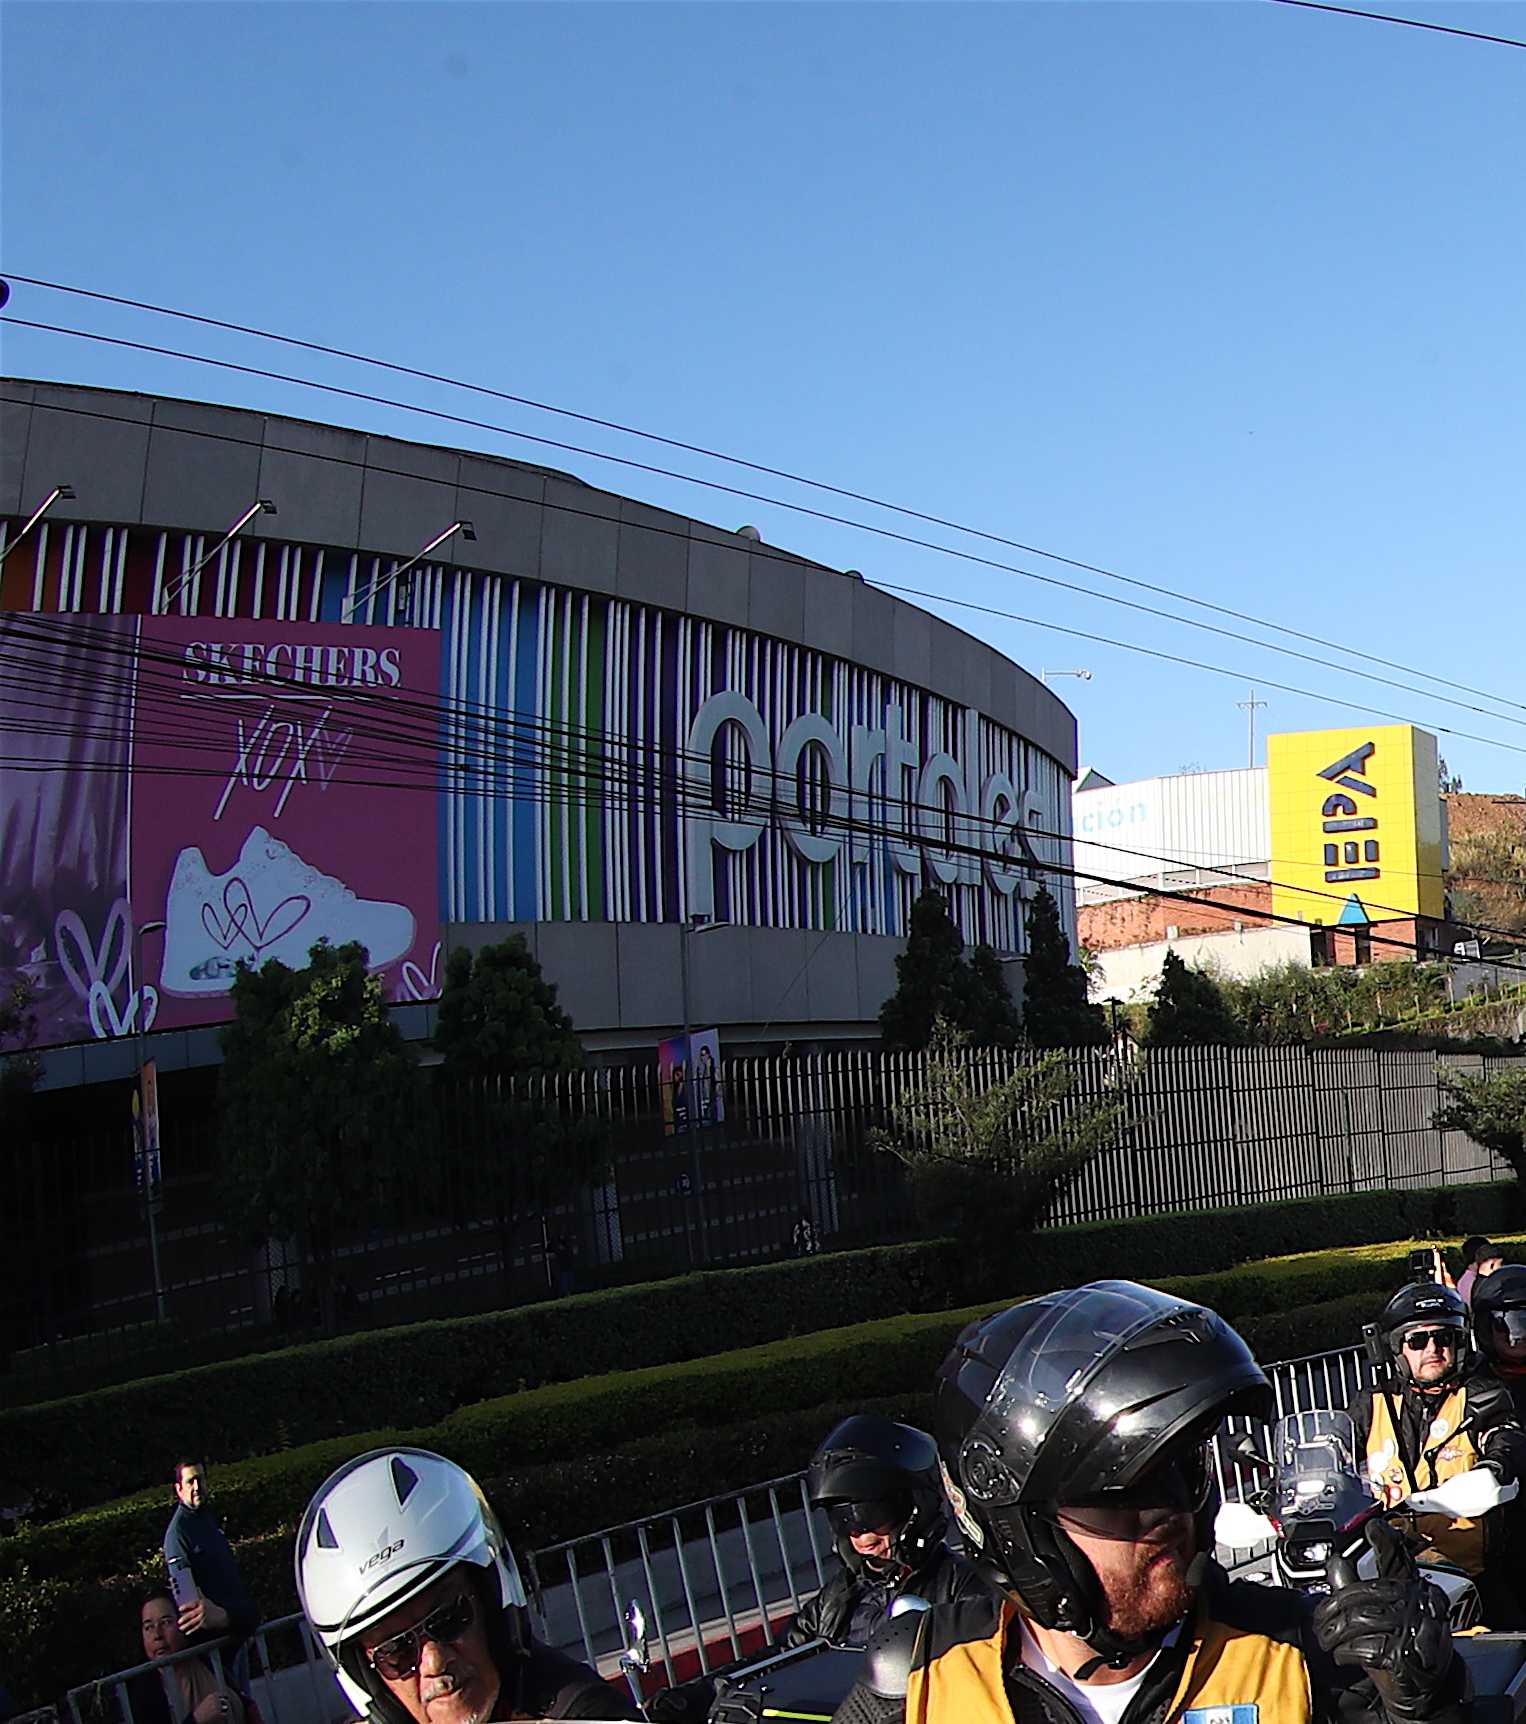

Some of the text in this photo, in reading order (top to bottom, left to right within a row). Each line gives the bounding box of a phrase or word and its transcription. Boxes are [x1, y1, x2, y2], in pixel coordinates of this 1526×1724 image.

[182, 641, 402, 687] SKECHERS
[688, 690, 1044, 917] portales
[1074, 797, 1148, 832] ción
[359, 1539, 405, 1575] vega
